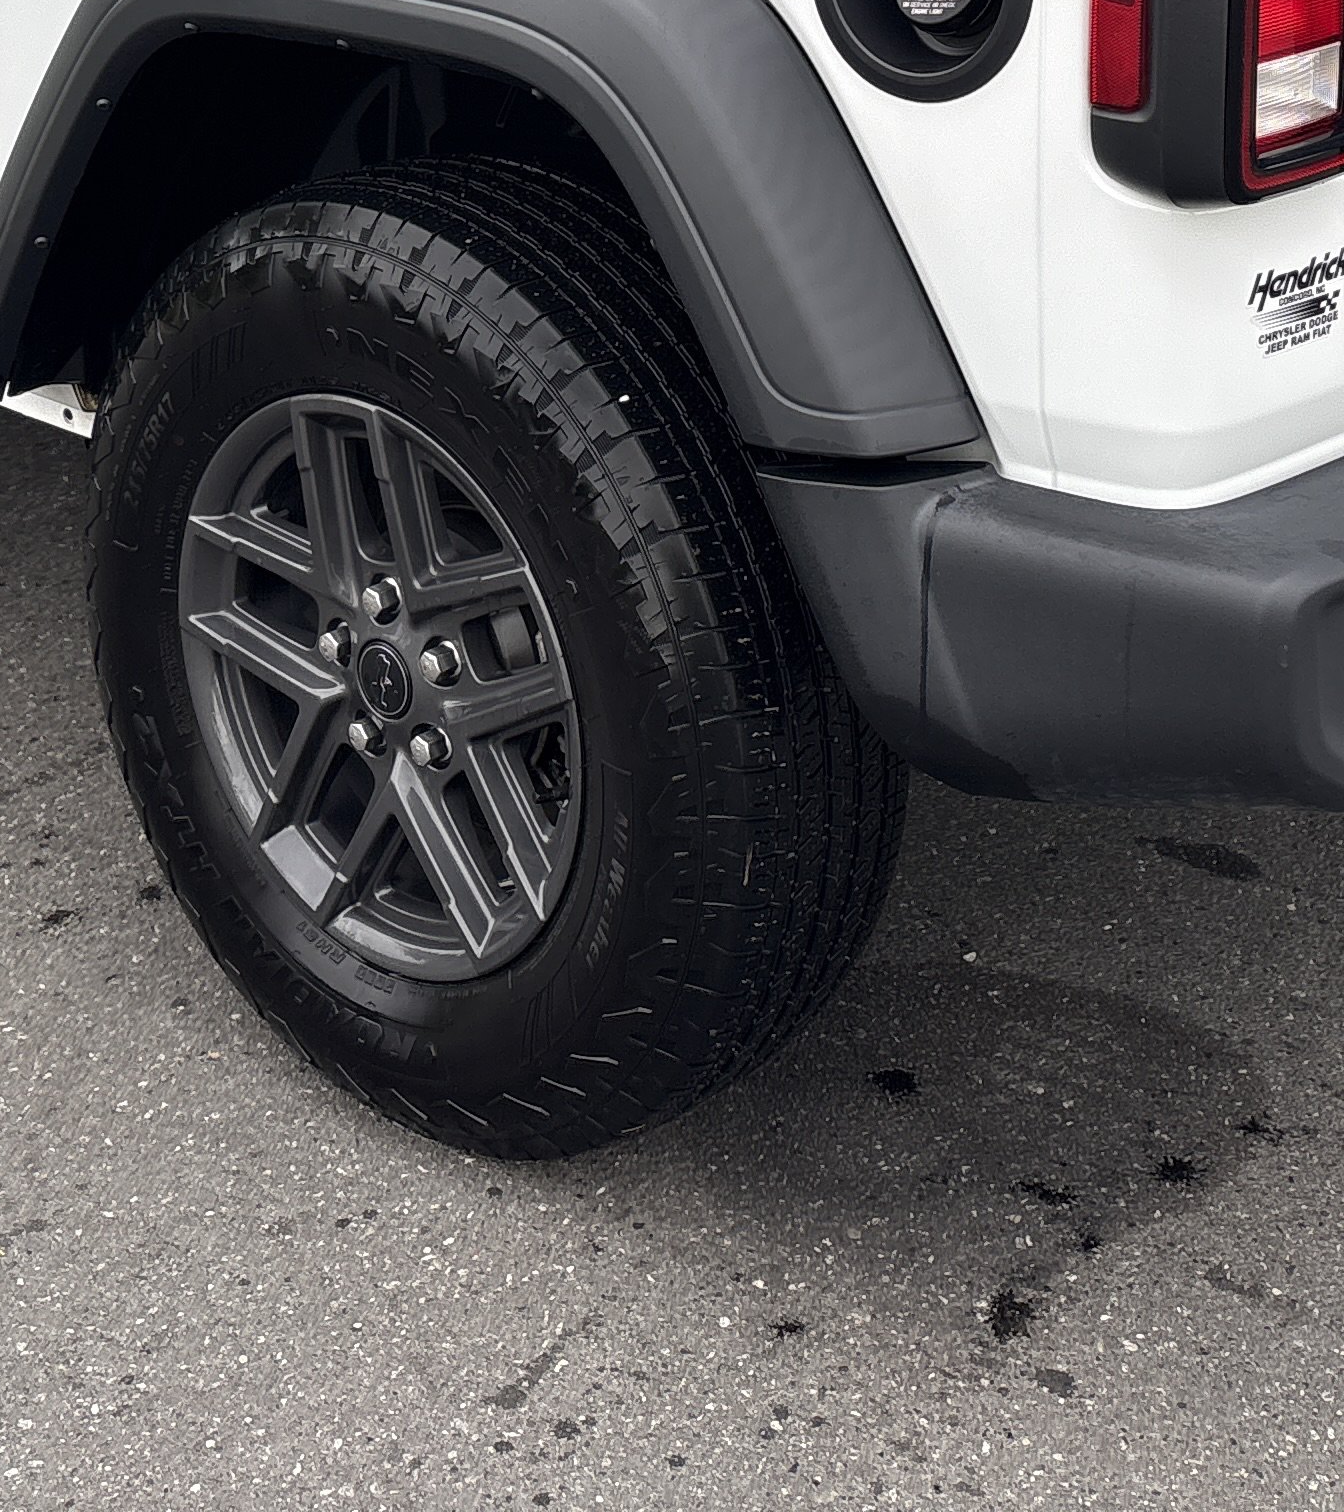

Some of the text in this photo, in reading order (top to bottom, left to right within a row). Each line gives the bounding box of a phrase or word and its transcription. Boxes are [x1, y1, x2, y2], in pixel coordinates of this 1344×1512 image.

[1258, 310, 1339, 346] CHRYSLER DODGE
[1264, 324, 1332, 355] JEEP RAM FIAT
[585, 811, 629, 970] All-Weather
